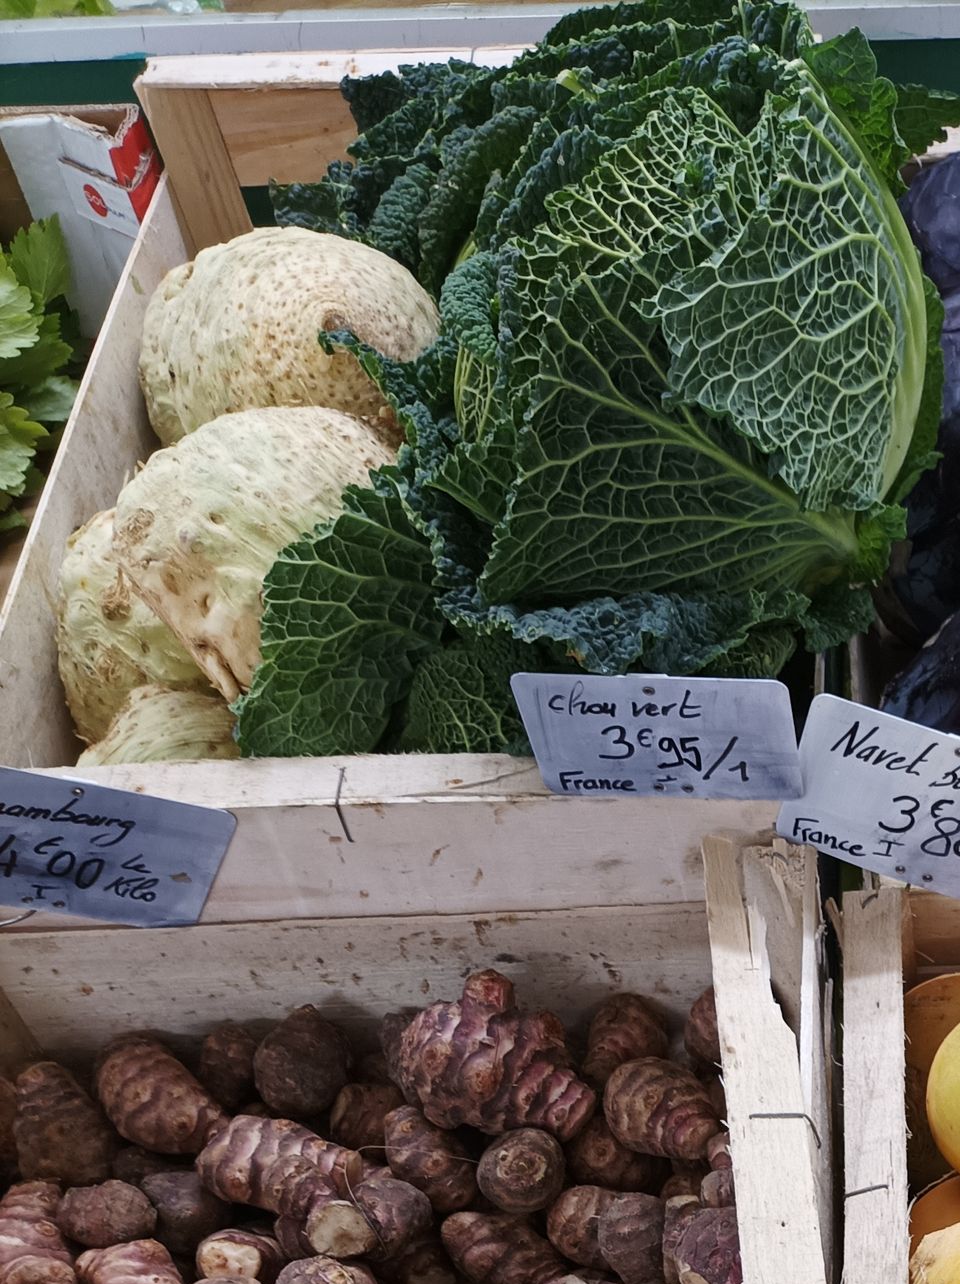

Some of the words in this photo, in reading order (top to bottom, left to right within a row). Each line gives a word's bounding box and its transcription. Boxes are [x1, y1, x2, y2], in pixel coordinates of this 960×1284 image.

[631, 690, 701, 719] vert
[830, 721, 939, 776] Navet
[559, 770, 638, 792] France
[792, 817, 866, 857] France
[103, 876, 159, 902] Kilo
